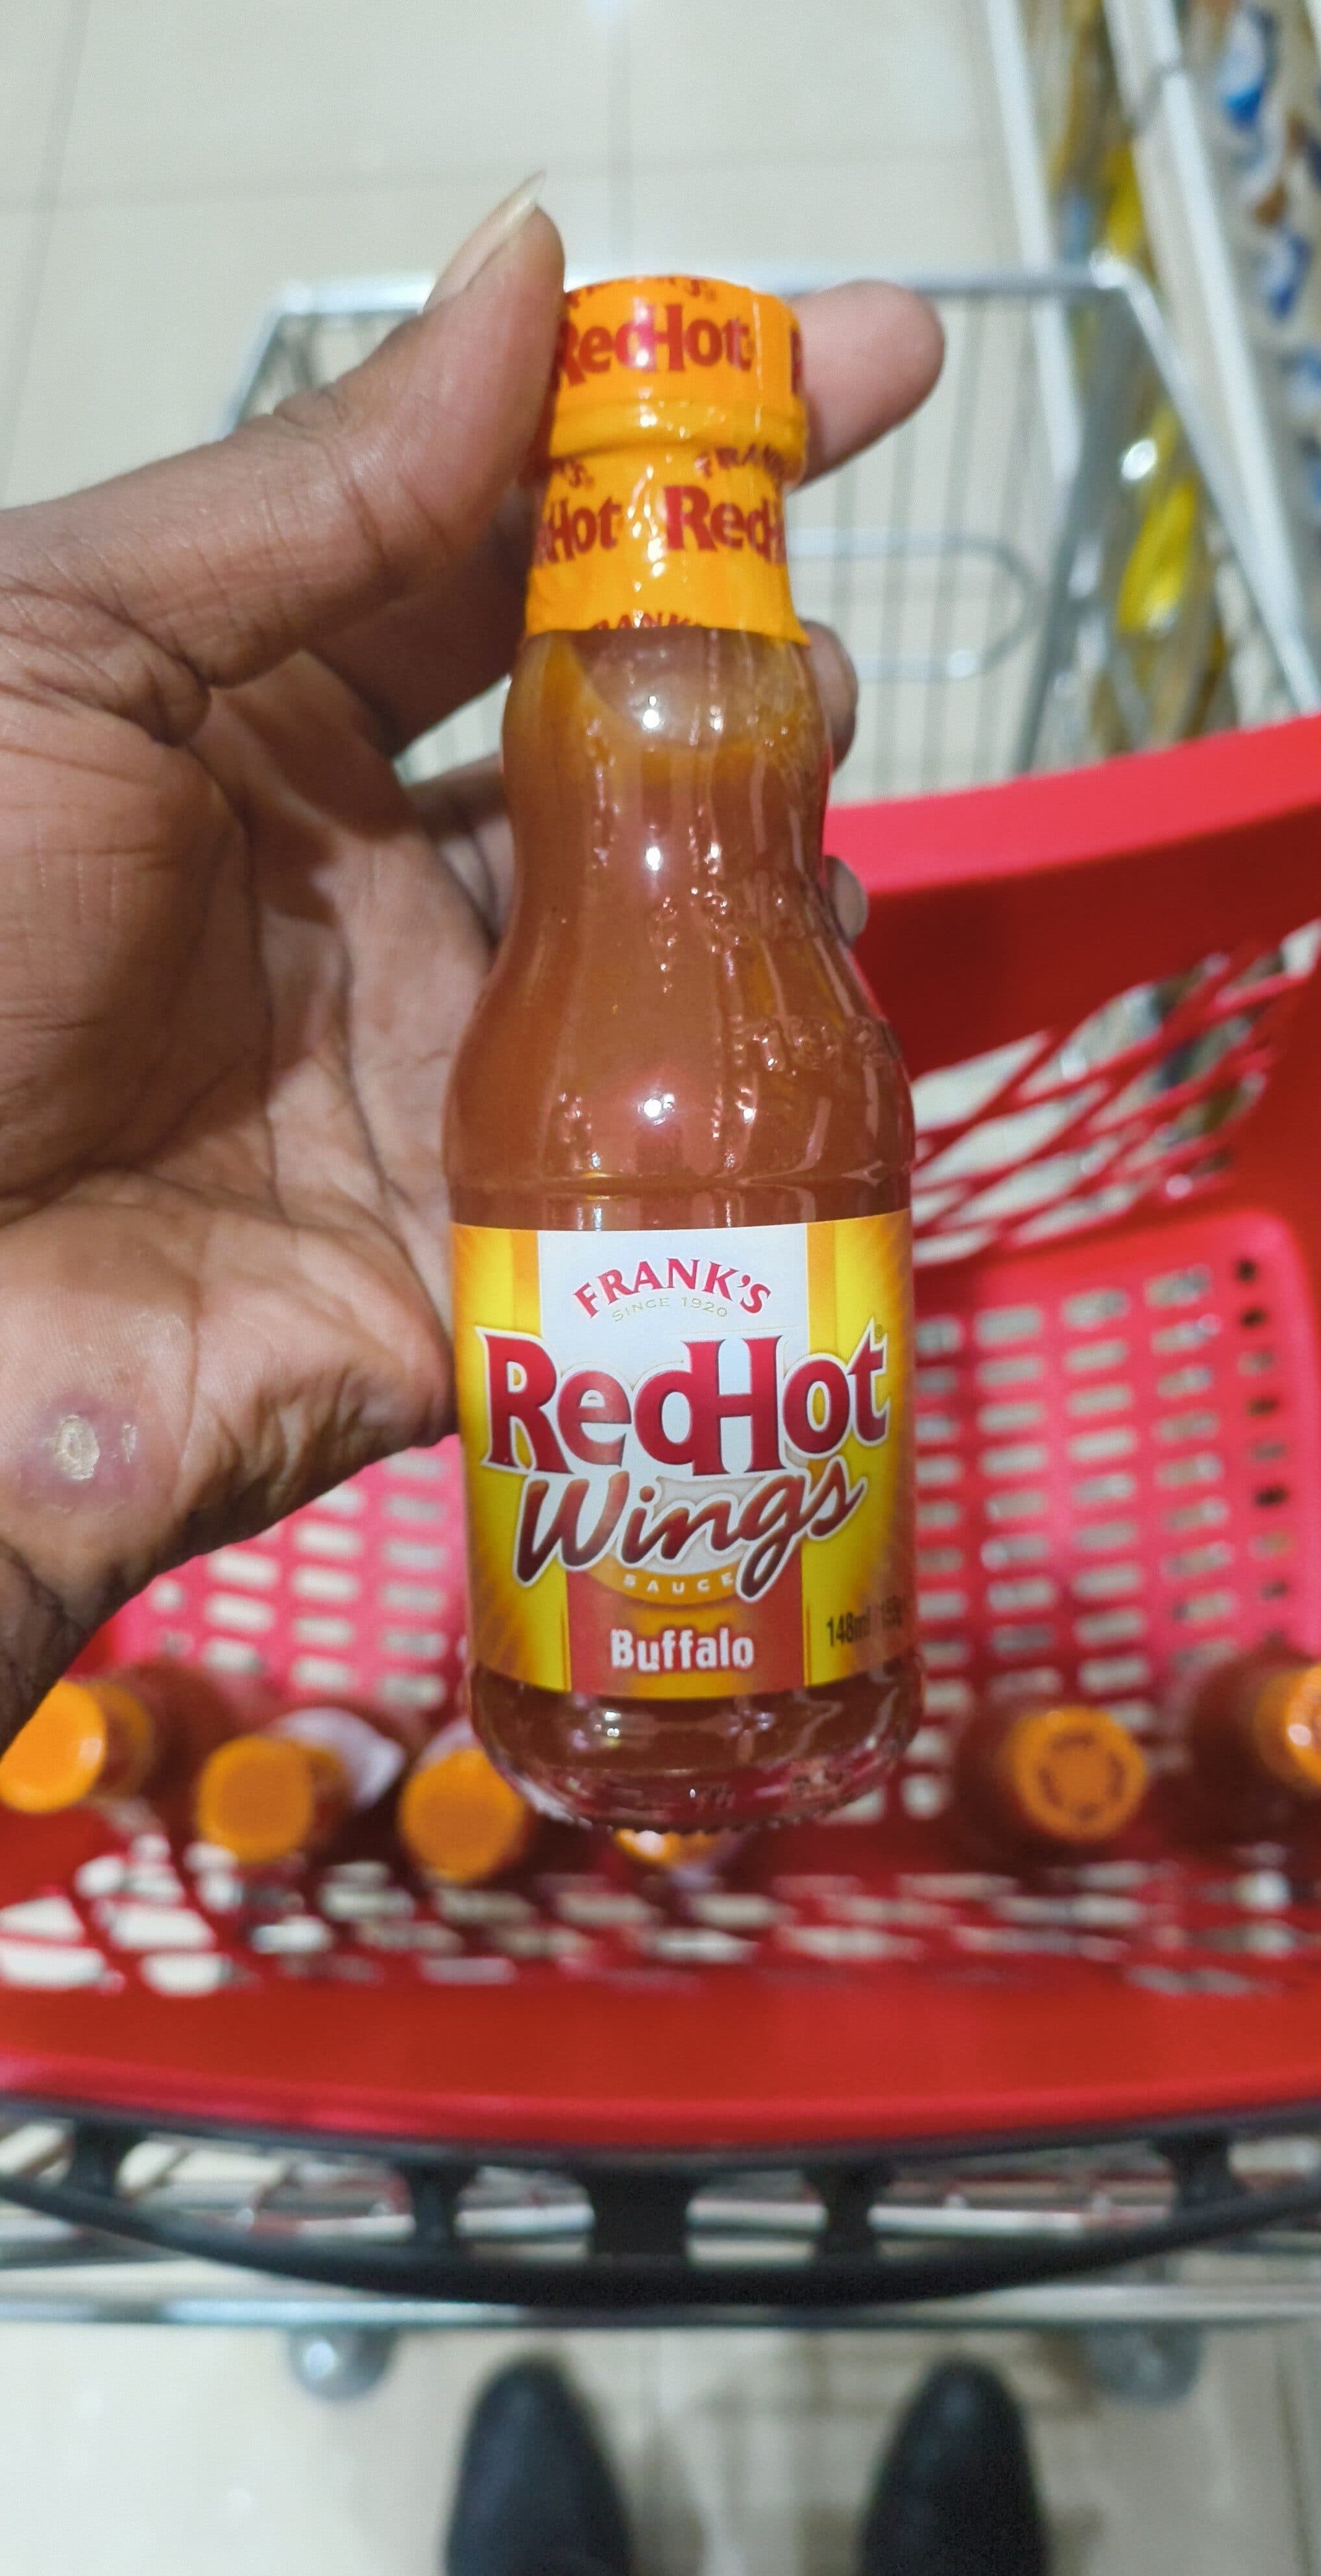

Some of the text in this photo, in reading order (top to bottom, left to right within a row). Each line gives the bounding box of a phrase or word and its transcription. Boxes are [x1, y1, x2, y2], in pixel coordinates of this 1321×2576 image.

[573, 1257, 772, 1319] FRANK'S
[612, 1296, 729, 1322] SINCE 1920
[483, 1329, 888, 1476] RedHot
[516, 1467, 866, 1598] Wings
[623, 1572, 734, 1595] SAUCE
[610, 1627, 755, 1672] Buffalo
